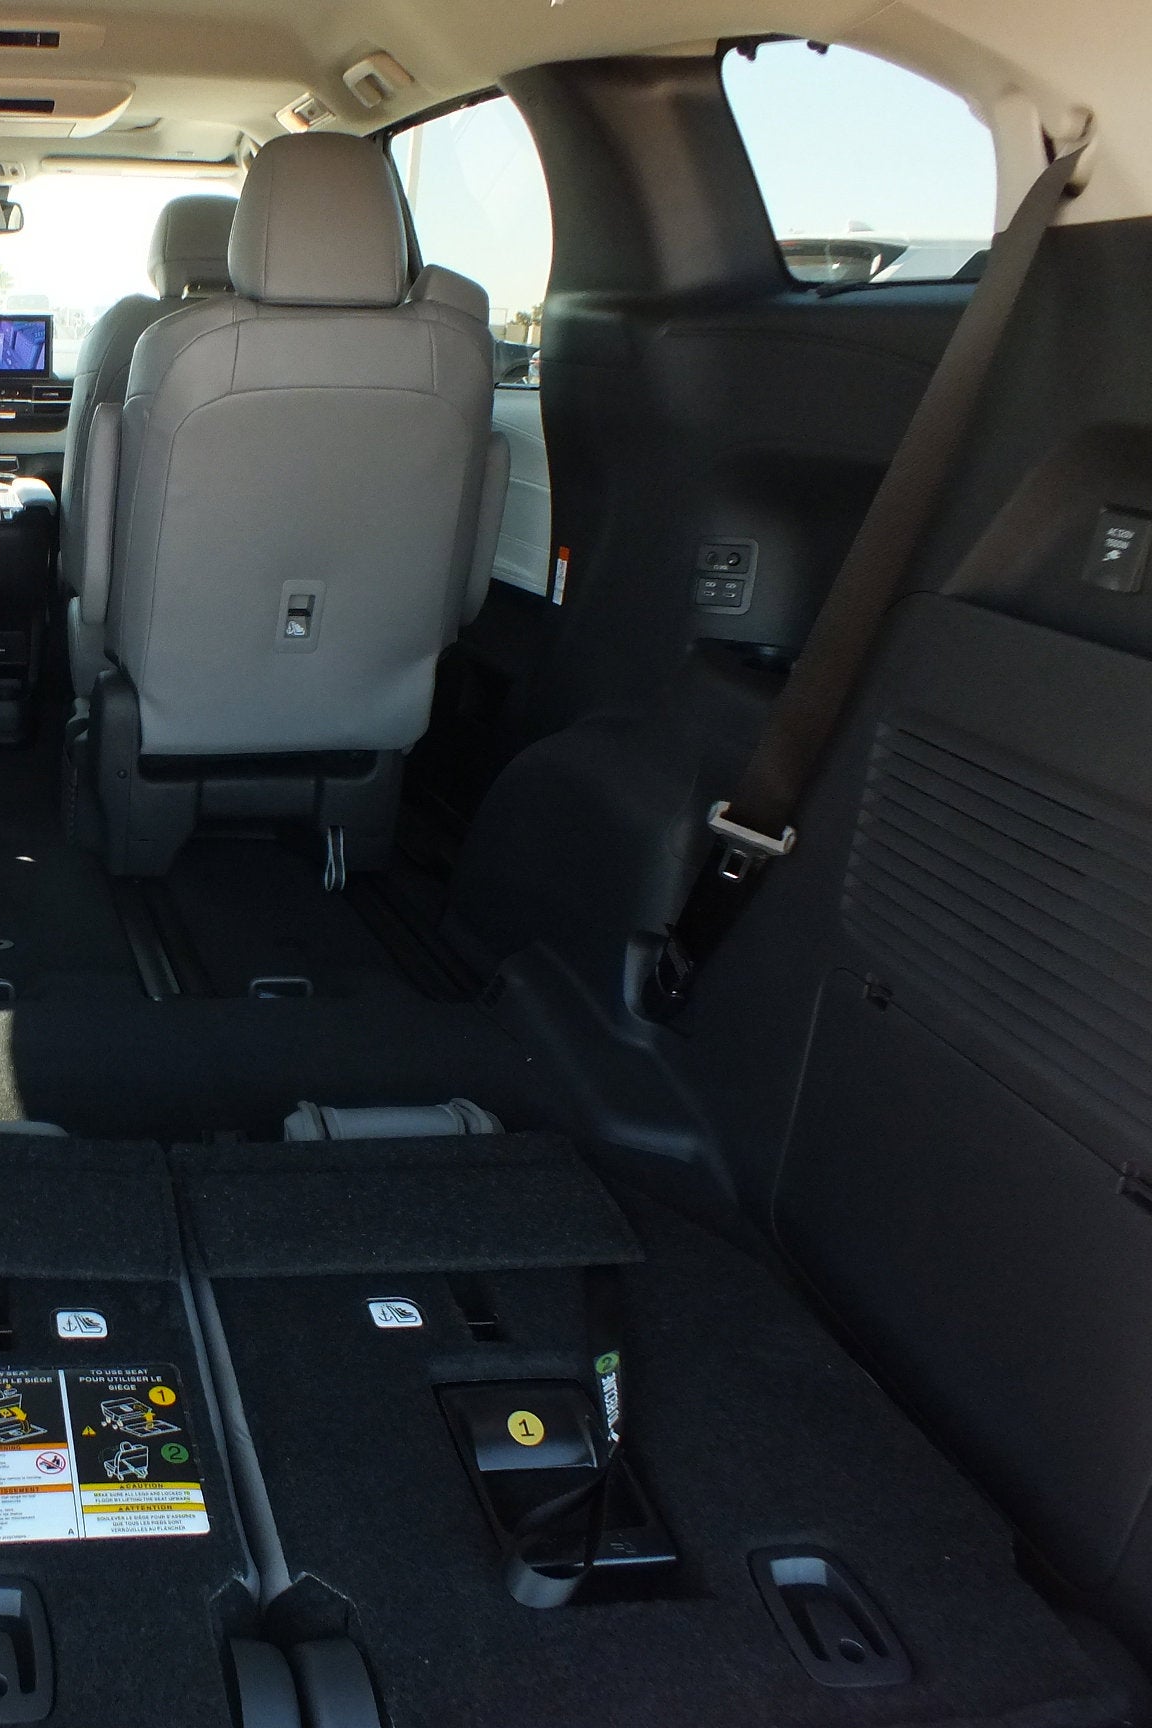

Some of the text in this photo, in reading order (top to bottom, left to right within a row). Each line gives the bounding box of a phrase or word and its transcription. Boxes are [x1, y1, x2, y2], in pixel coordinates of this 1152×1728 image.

[602, 1356, 613, 1372] 2
[108, 1383, 137, 1391] SIÈGE
[157, 1389, 166, 1402] 1
[518, 1418, 535, 1437] 1
[168, 1445, 183, 1460] 2
